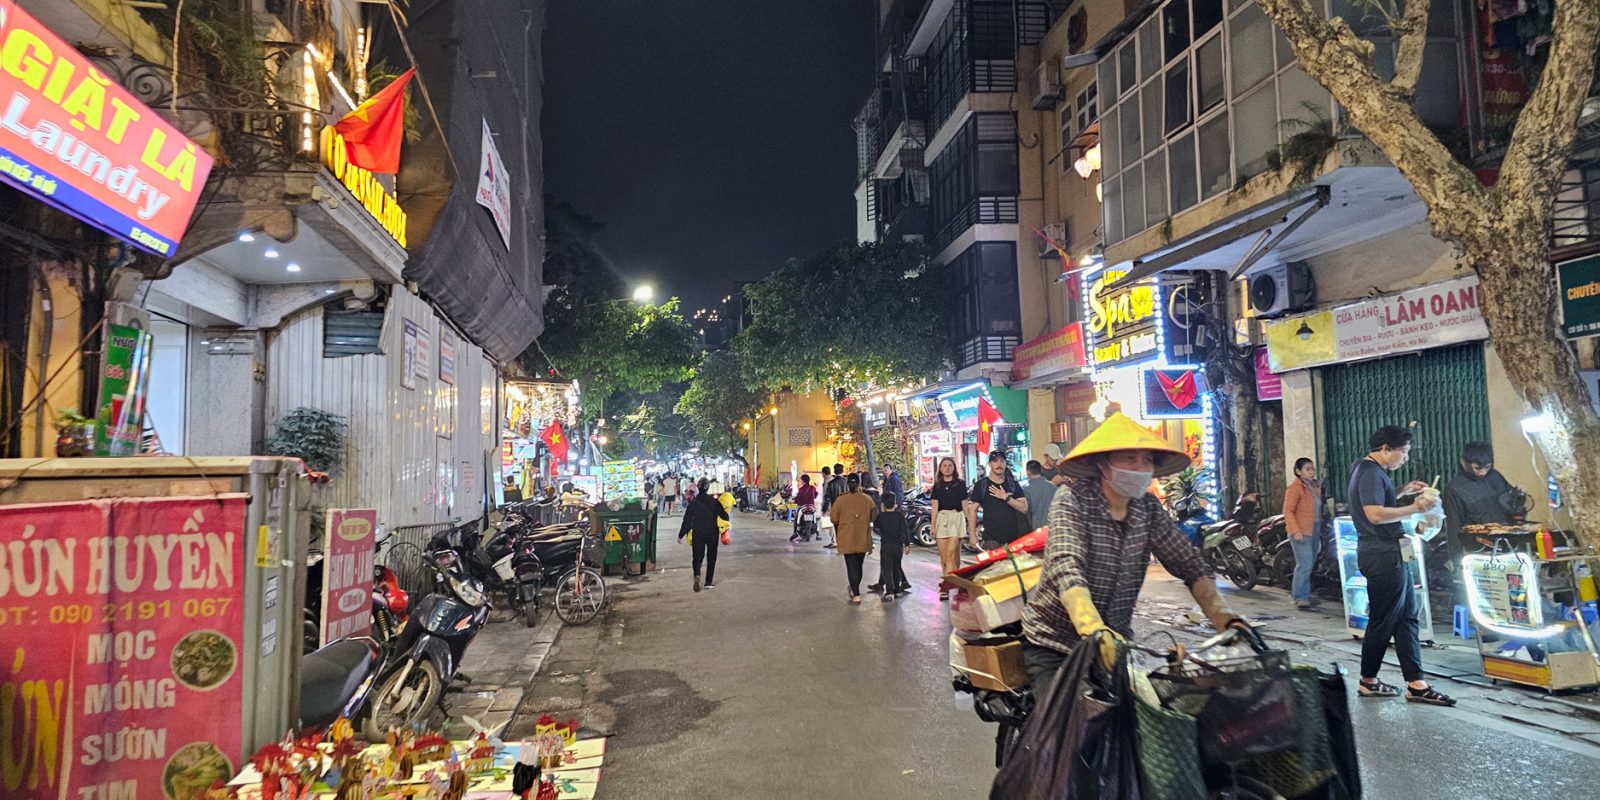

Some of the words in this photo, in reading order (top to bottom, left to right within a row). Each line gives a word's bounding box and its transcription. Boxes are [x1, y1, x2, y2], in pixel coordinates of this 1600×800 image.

[2, 28, 140, 144] GIẶT
[140, 128, 197, 192] LÀ
[1, 92, 170, 220] Laundry
[1089, 277, 1131, 338] Spa
[1354, 305, 1379, 320] HÀNG
[1384, 295, 1426, 326] LÂM
[1400, 325, 1419, 336] BÁNH
[86, 508, 235, 595] HUYỀN
[50, 604, 93, 624] 090
[102, 600, 171, 623] 2191
[182, 597, 232, 618] 067
[87, 630, 157, 668] MỌC
[84, 674, 177, 715] MÓNG
[80, 722, 167, 766] SƯỜN
[78, 779, 138, 800] TIM
